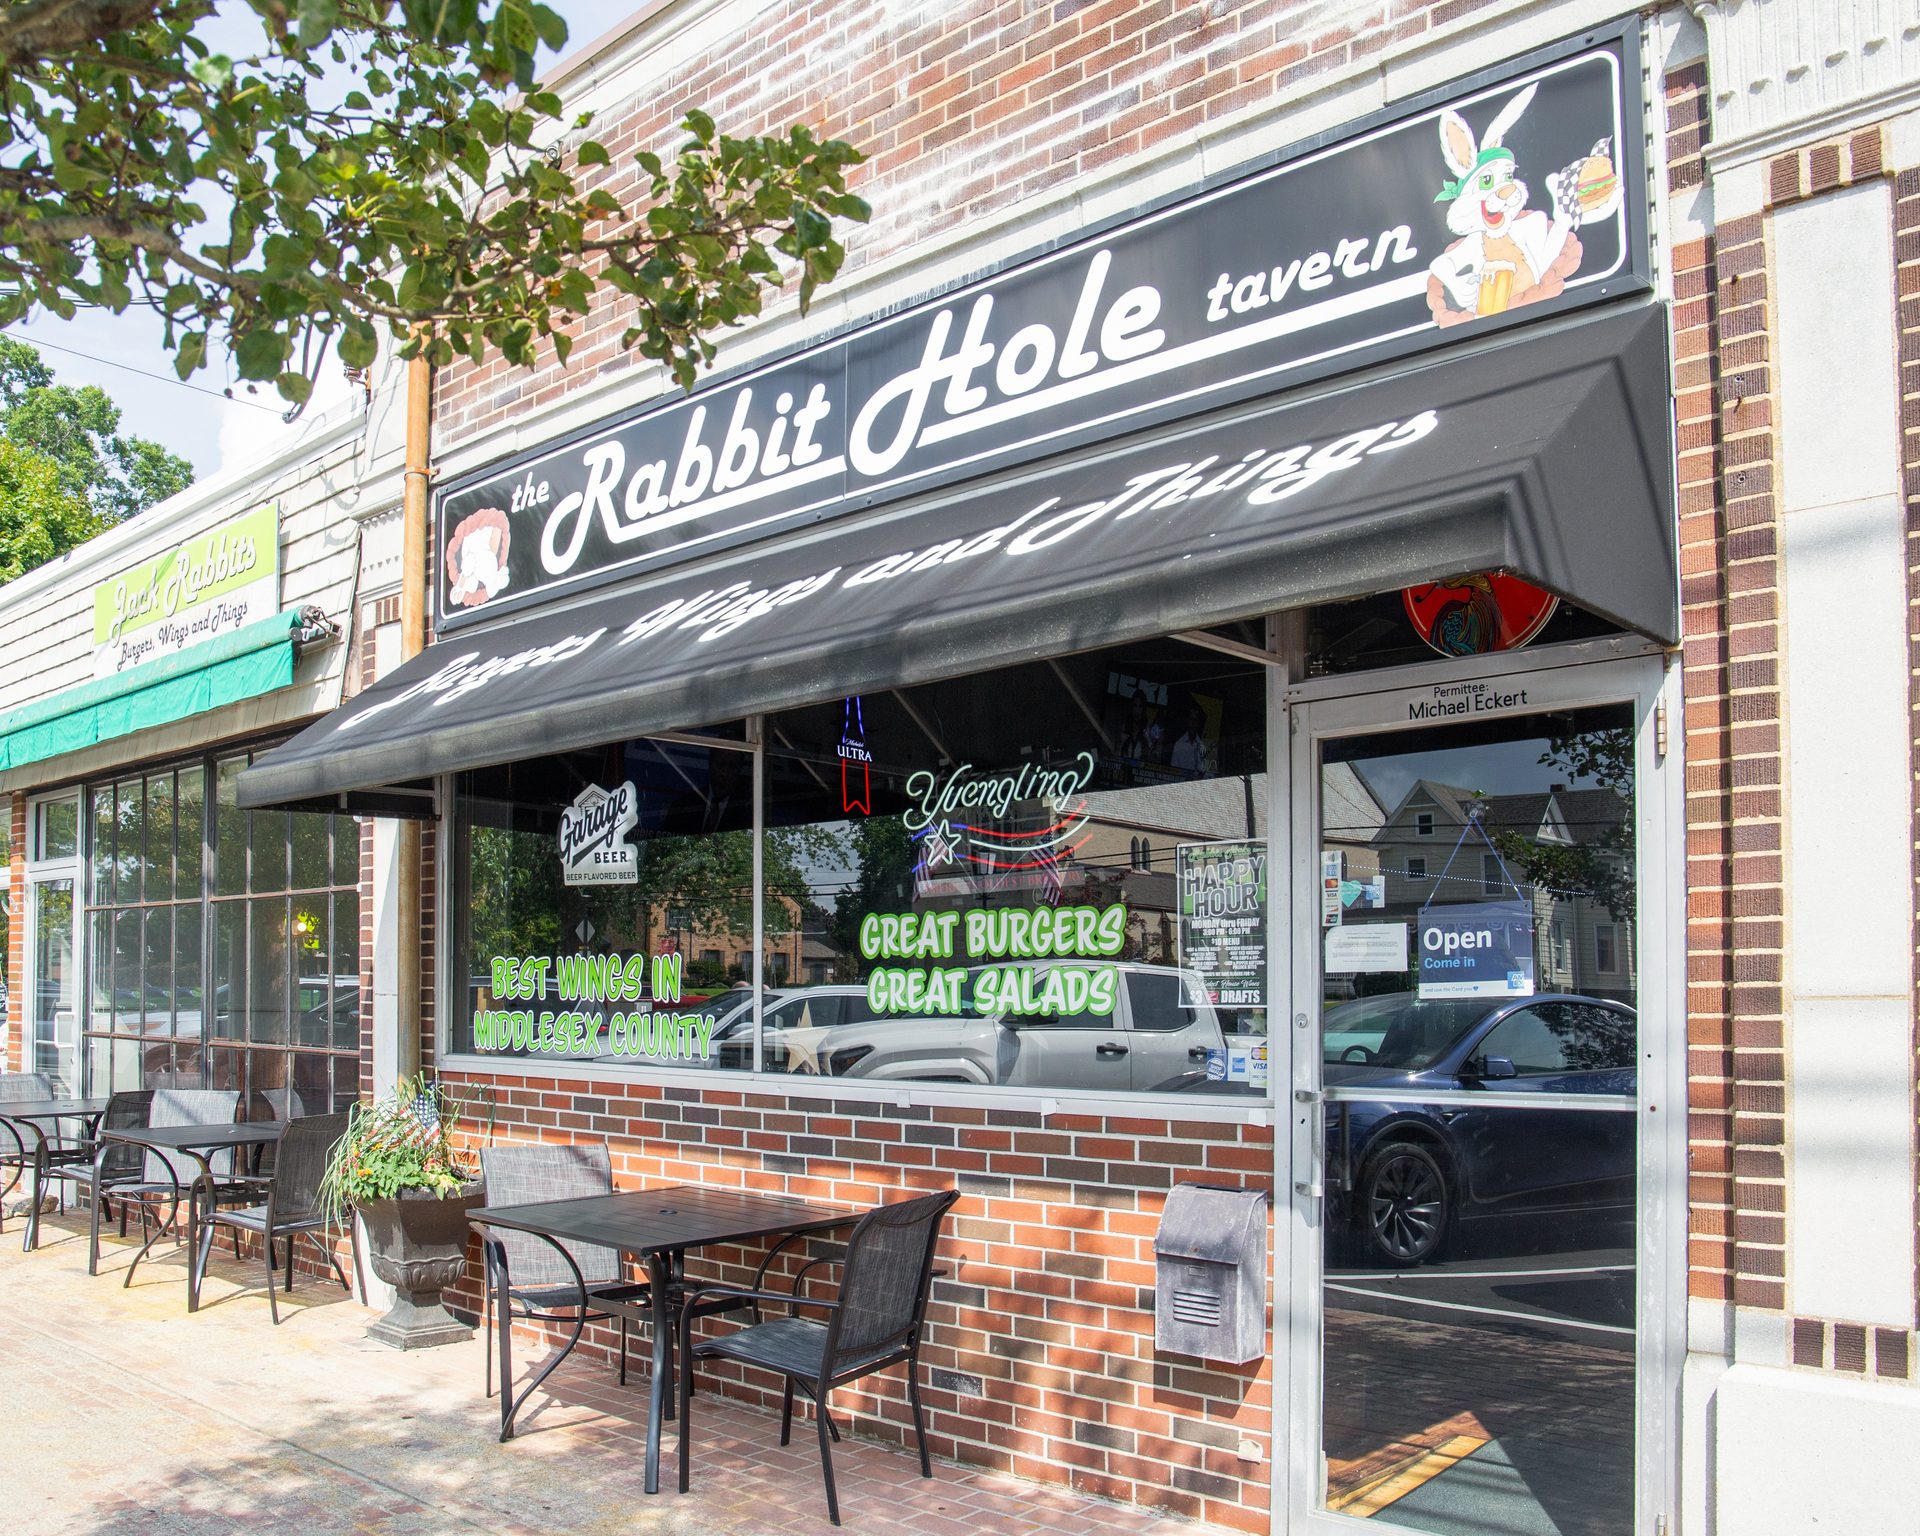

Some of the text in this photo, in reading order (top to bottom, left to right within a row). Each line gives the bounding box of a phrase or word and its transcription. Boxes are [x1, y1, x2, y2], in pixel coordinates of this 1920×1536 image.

[510, 224, 1418, 575] the Rabbit Hole tavern
[842, 496, 1060, 589] and
[1006, 410, 1439, 555] Things
[109, 533, 256, 648] Jack Rabbits
[117, 602, 248, 671] Burgers, Wings and Things
[1409, 690, 1528, 720] Michael Eckert
[1433, 684, 1489, 698] Permittee:
[837, 745, 873, 762] ULTRA
[903, 751, 1094, 830] Yuengling
[560, 788, 628, 864] Garage
[566, 871, 636, 881] BEER FLAVORED BEER
[594, 851, 628, 864] BEER
[1184, 855, 1265, 896] HAPPY
[1193, 883, 1258, 919] HOUR
[860, 903, 1127, 959] GREAT BURGERS
[1191, 918, 1260, 929] MONDAY thru FRIDAY
[1222, 937, 1240, 945] MENU
[1423, 927, 1492, 956] Open
[491, 952, 682, 1003] BEST WINGS IN
[1424, 956, 1475, 969] Come in
[867, 965, 1119, 1016] GREAT SALADS
[1220, 989, 1260, 1003] DRAFTS
[474, 1010, 715, 1061] MIDDLESEX COUNTY
